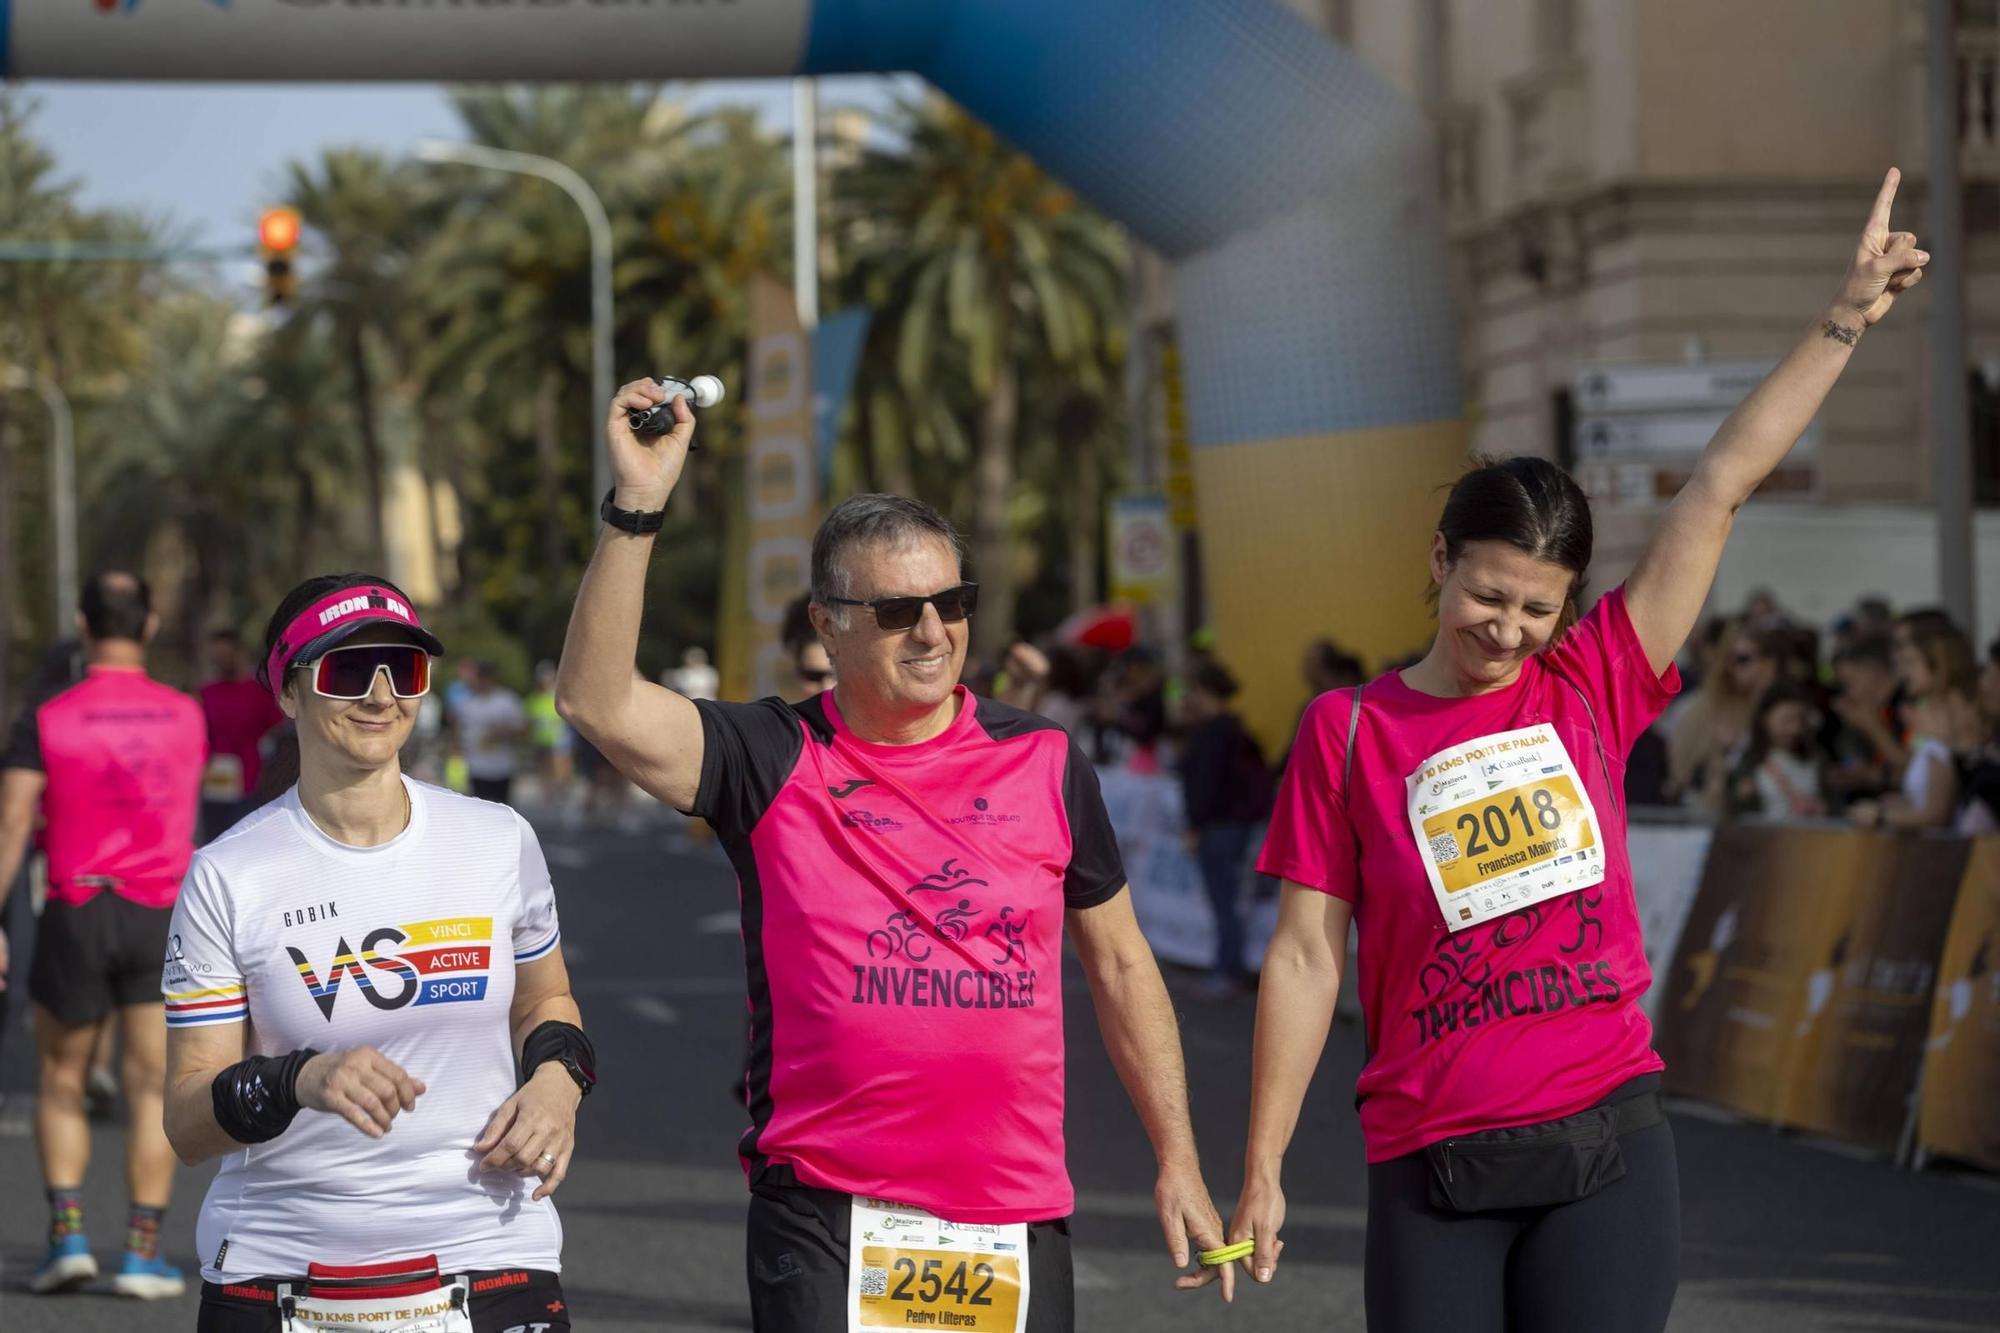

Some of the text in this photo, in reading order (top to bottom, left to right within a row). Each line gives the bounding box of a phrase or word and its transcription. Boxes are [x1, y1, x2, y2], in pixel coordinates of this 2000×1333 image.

[319, 593, 409, 626] IRONMAN
[1425, 767, 1436, 778] 10
[1437, 755, 1464, 774] KMS
[1465, 746, 1495, 763] PORT
[1497, 741, 1511, 753] DE
[1513, 734, 1549, 749] PALMA
[1499, 753, 1538, 770] CaixaBank
[1457, 789, 1561, 858] 2018
[1477, 851, 1528, 876] Francisca
[1527, 836, 1568, 859] Mairata
[284, 901, 338, 928] GOBIK
[429, 922, 472, 938] VINCI
[429, 951, 480, 969] ACTIVE
[429, 981, 478, 999] SPORT
[852, 965, 1037, 1009] INVENCIBLES
[1411, 960, 1621, 1047] INVENCIBLES
[896, 1217, 923, 1226] Mallorca
[473, 1272, 528, 1292] IRONMAN
[891, 1257, 994, 1306] 2542
[223, 1284, 274, 1301] IRONMAN
[312, 1311, 323, 1321] 10
[326, 1313, 354, 1322] KMS
[358, 1311, 392, 1323] PORT
[395, 1308, 411, 1320] DE
[906, 1309, 976, 1327] Pedro Lliteras
